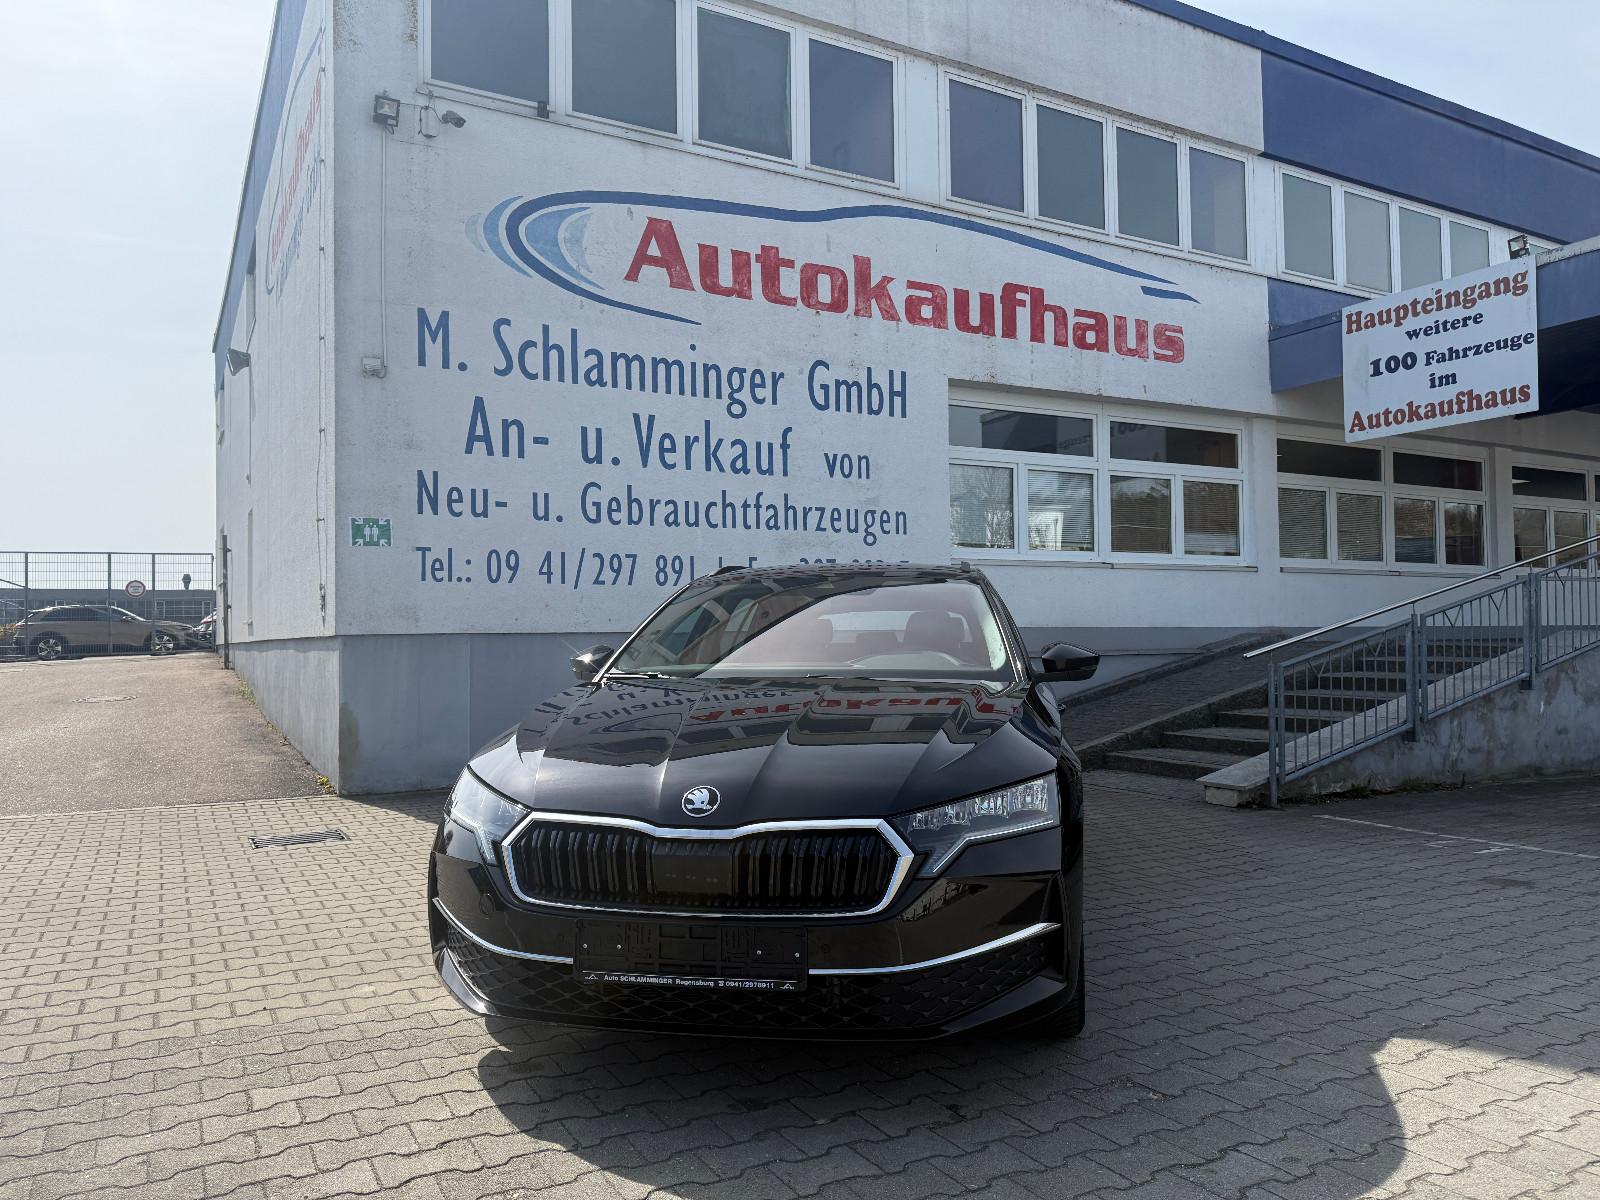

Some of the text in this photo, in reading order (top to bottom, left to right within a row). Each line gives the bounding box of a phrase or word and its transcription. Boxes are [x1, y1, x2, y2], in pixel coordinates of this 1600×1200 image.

[624, 216, 1184, 362] Autokaufhaus
[1345, 269, 1529, 335] Haupteingang
[1404, 312, 1484, 341] weitere
[416, 307, 907, 419] M. Schlamminger GmbH
[1369, 332, 1535, 378] 100 Fahrzeuge
[1428, 372, 1458, 389] im
[1348, 384, 1531, 433] Autokaufhaus
[464, 395, 871, 480] An- u. Verkauf von
[416, 469, 908, 547] Neu- u. Gebrauchtfahrzeugen
[415, 546, 472, 583] Tel.:
[486, 548, 520, 584] 09
[538, 547, 638, 590] 41/297
[655, 554, 696, 587] 891
[603, 974, 619, 982] Auto
[619, 975, 673, 985] SCHLAMMINGER
[675, 978, 714, 988] Regensburg
